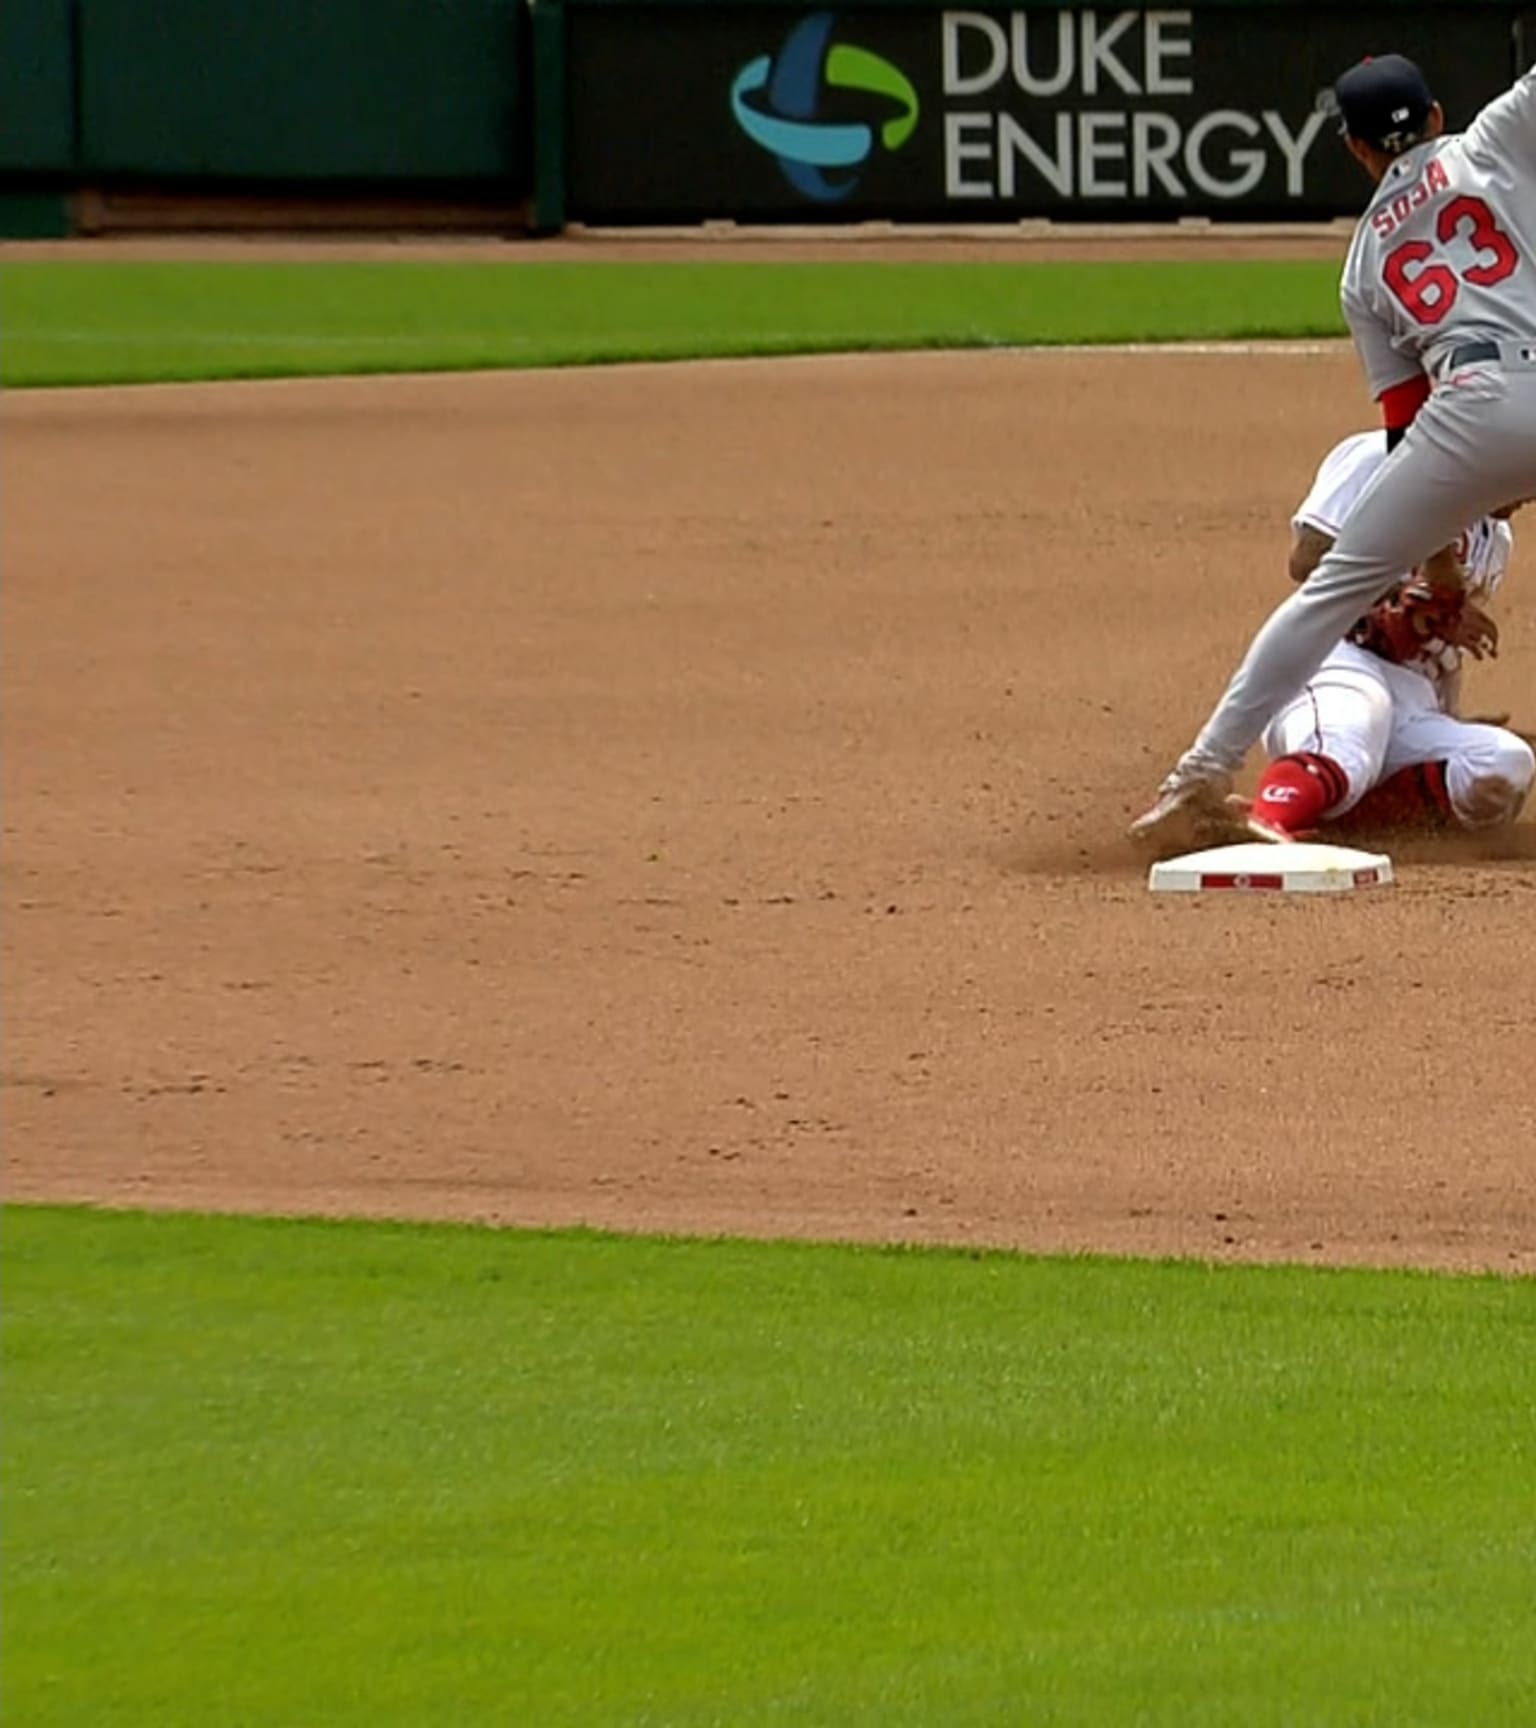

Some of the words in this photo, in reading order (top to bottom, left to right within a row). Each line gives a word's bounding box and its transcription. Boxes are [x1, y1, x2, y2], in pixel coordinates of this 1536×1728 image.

[942, 11, 1194, 95] DUKE
[944, 110, 1325, 198] ENERGY
[1381, 194, 1519, 326] 63
